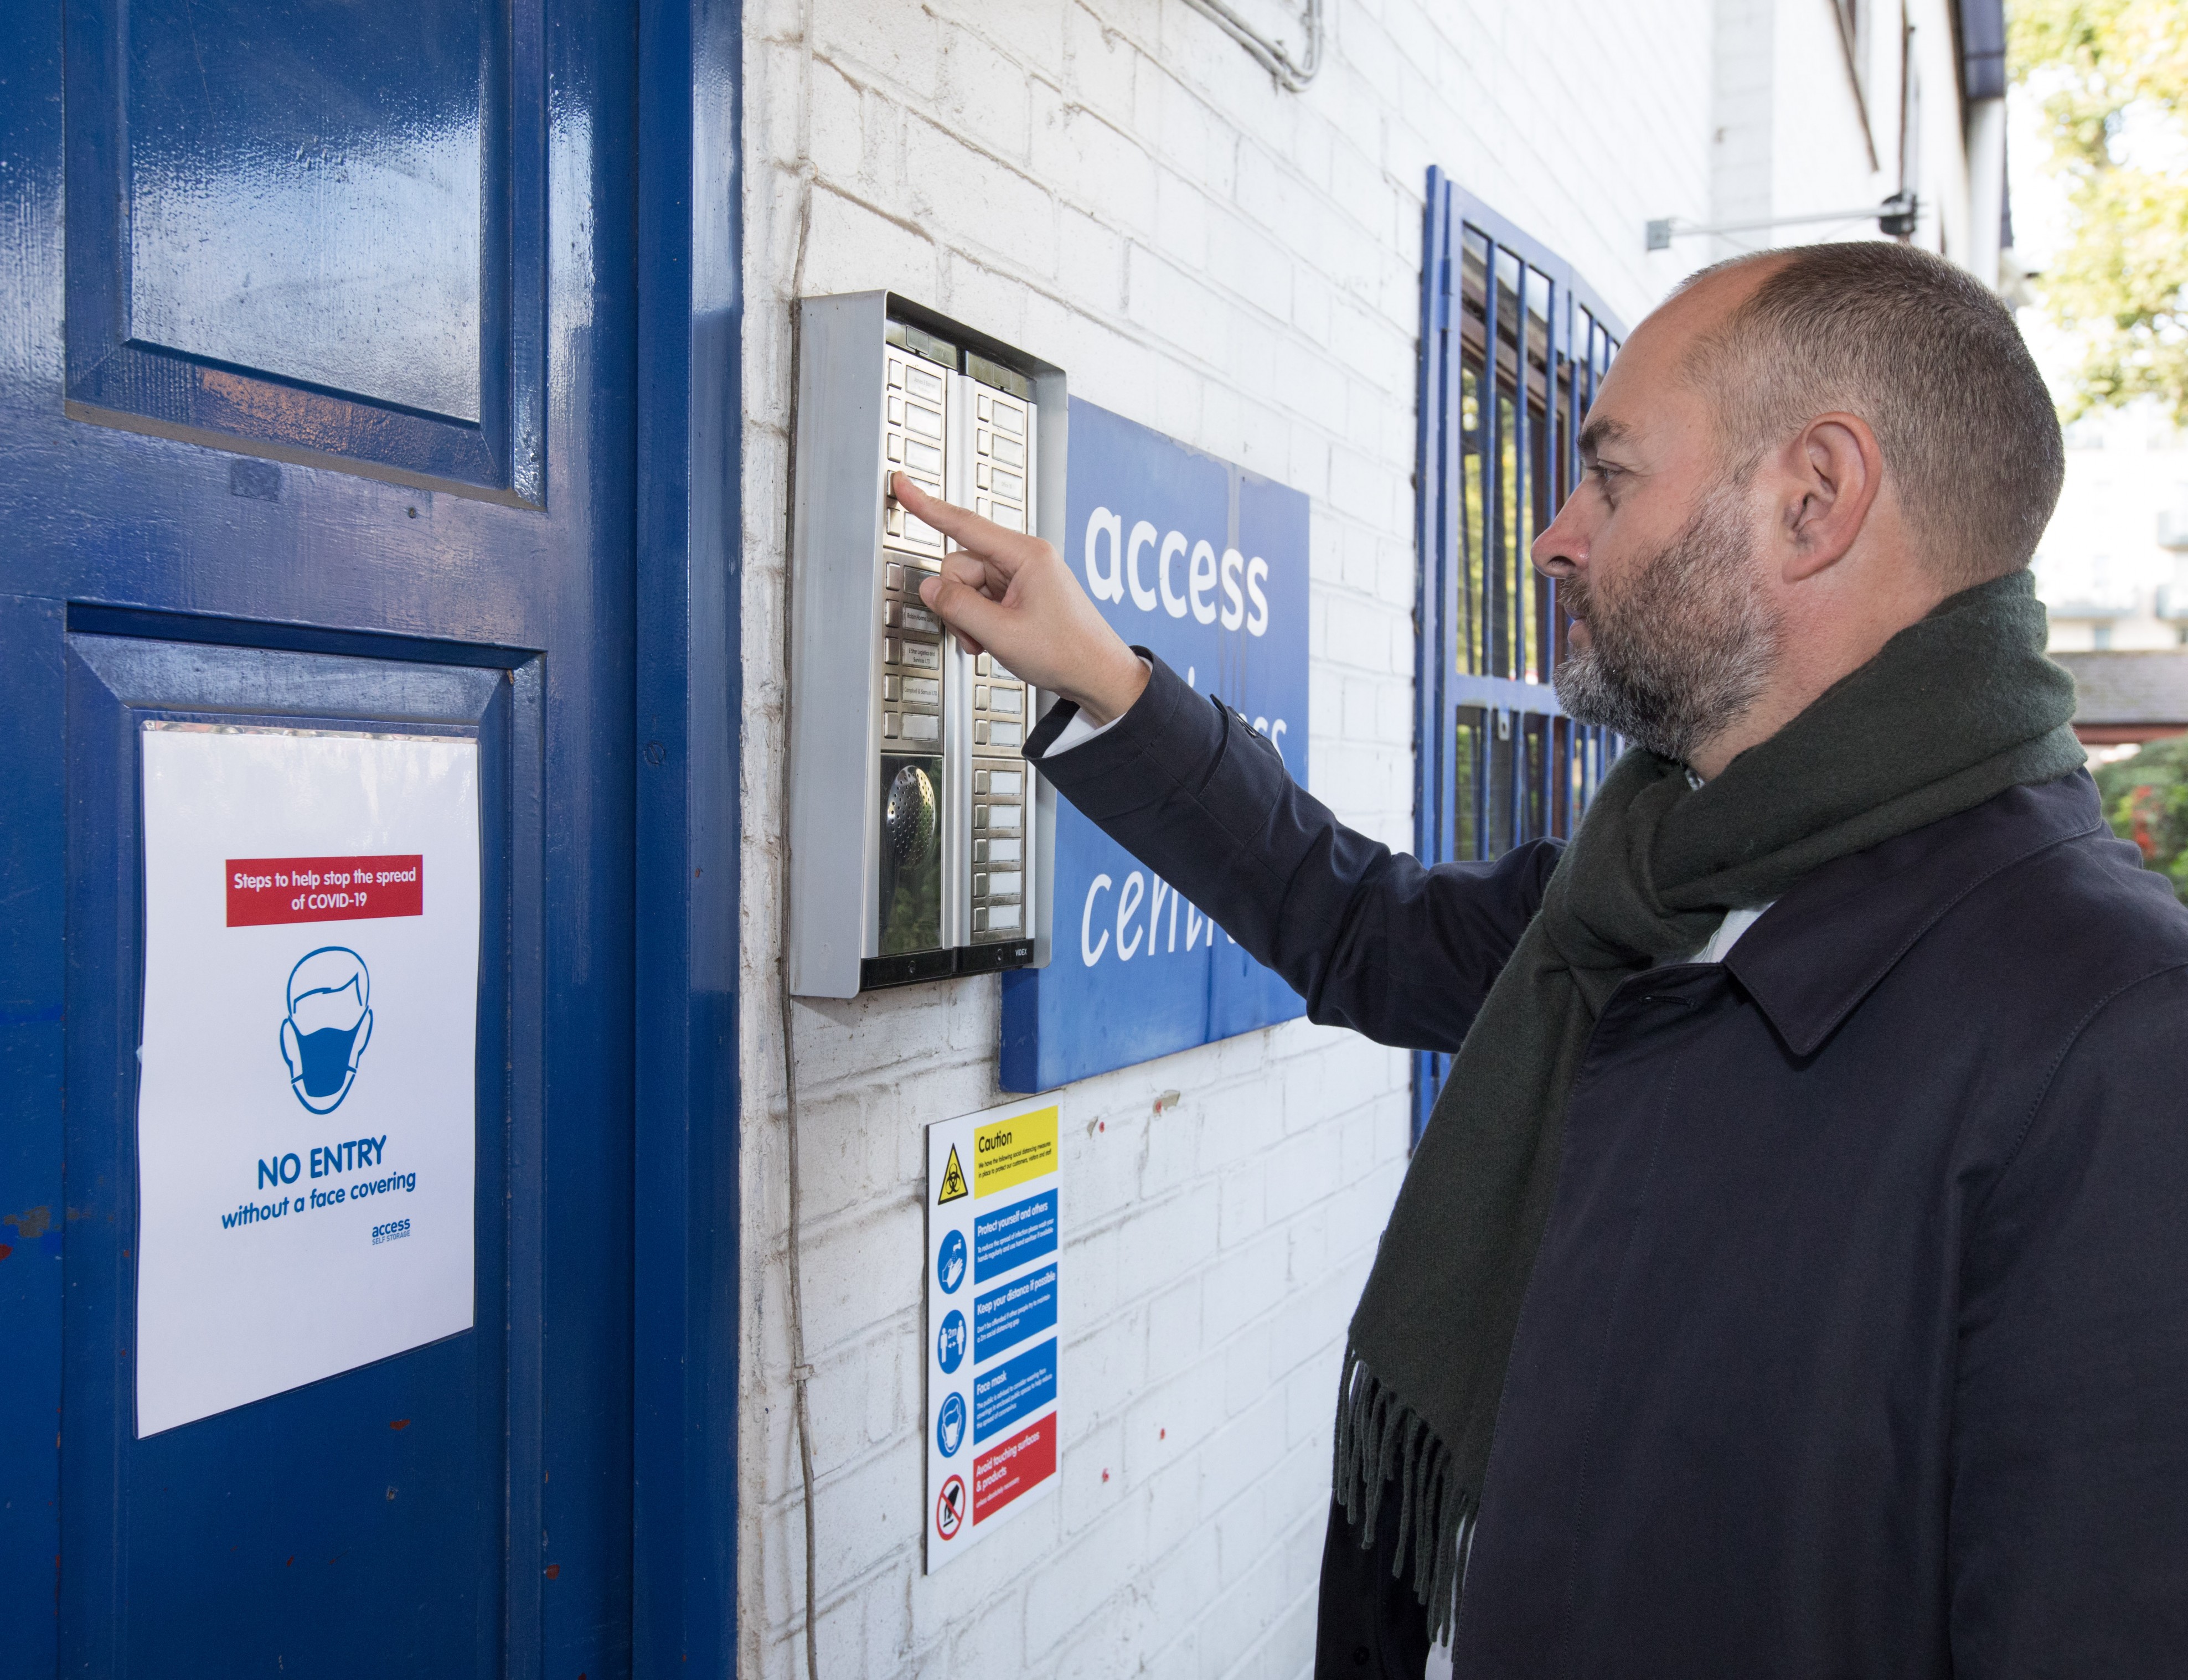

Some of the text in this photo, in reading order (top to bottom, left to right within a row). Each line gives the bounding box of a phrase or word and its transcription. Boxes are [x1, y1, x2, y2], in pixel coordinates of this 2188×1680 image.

[1085, 506, 1268, 637] access
[234, 867, 416, 892] Steps to help stop the spread
[291, 892, 367, 910] of COVID-19
[979, 1130, 1012, 1152] Caution
[259, 1135, 386, 1190] NO ENTRY
[221, 1172, 416, 1229] without a face covering
[372, 1218, 410, 1238] access
[978, 1202, 1048, 1237] Protect yourself and others
[372, 1230, 410, 1245] SELF STORAGE
[977, 1271, 1056, 1315] Keep your distance if possible
[948, 1328, 957, 1339] 2m
[977, 1371, 1007, 1395] Face mask
[976, 1432, 1040, 1477] Avoid touching surfaces
[976, 1467, 1007, 1492] & products
